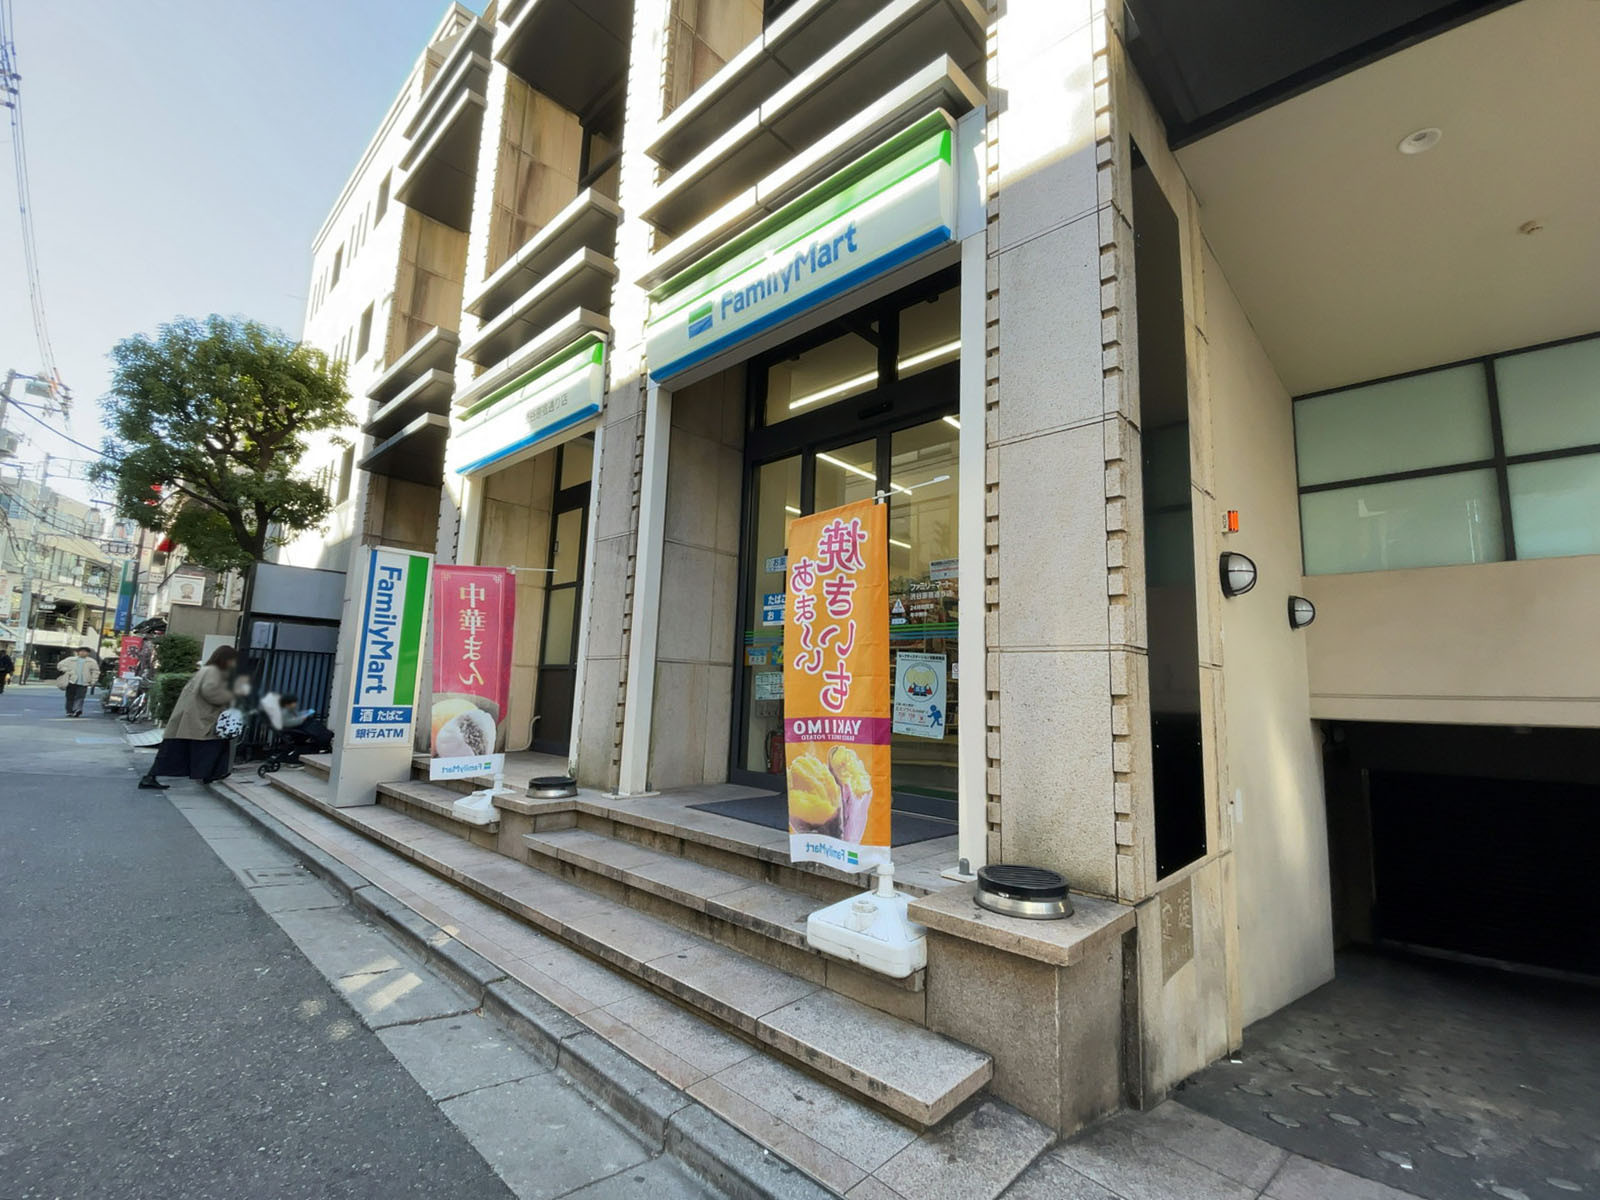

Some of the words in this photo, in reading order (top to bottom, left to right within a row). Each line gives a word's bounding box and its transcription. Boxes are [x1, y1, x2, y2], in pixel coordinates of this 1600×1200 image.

[720, 222, 859, 321] FamilyMart
[365, 566, 403, 694] FamilyMart
[355, 728, 404, 739] 銀行ATM
[359, 709, 374, 722] 酒
[377, 710, 404, 721] たばこ
